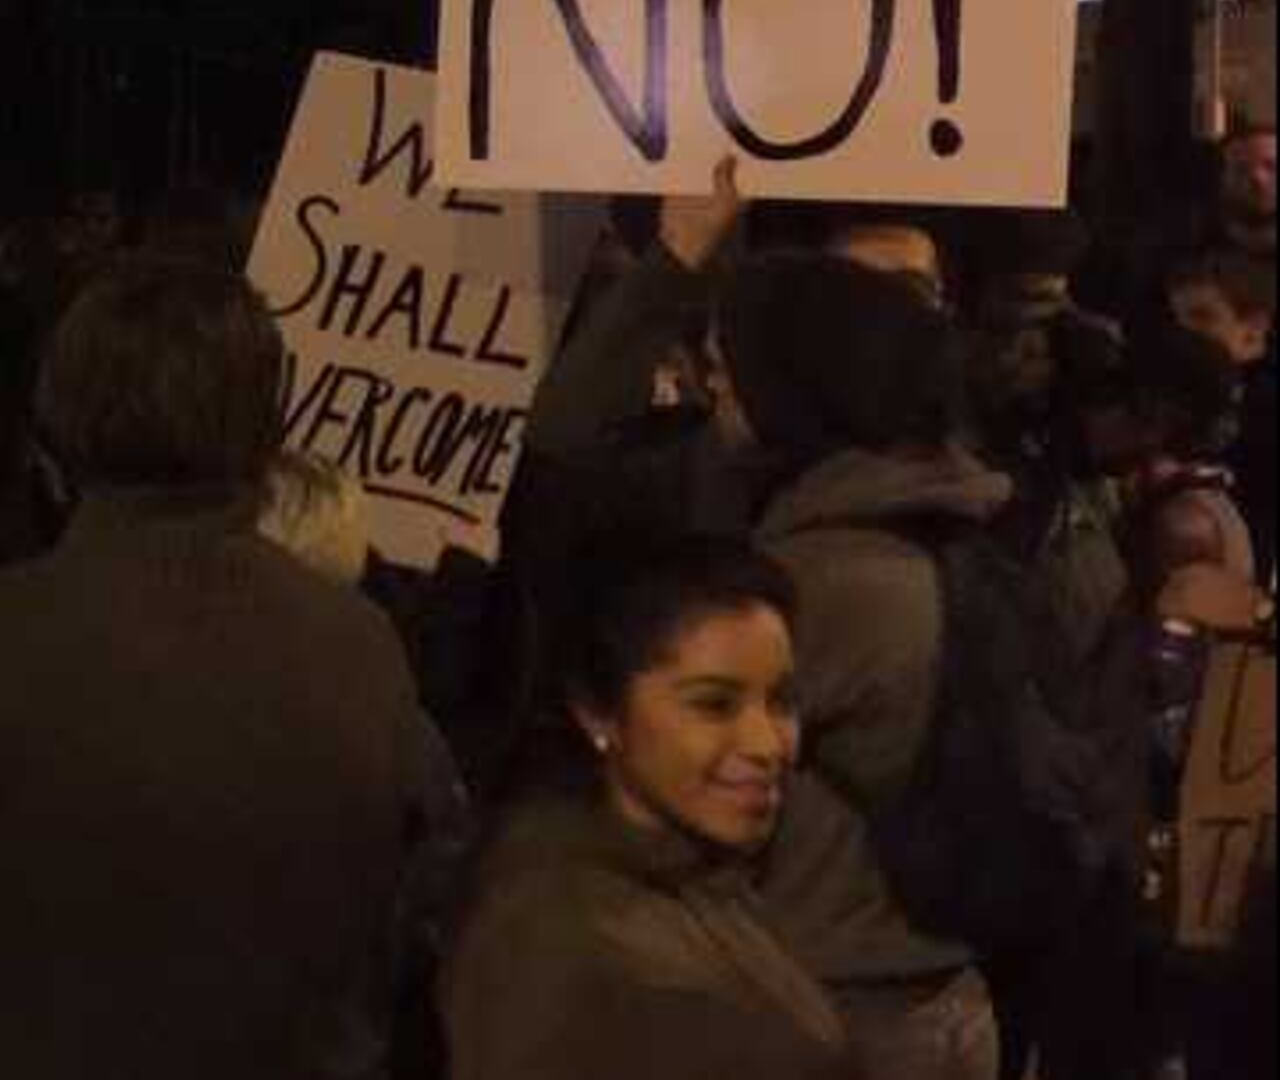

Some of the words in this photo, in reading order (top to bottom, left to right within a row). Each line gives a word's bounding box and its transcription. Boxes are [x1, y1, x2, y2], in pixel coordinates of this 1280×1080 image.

[357, 66, 503, 215] W
[264, 195, 528, 369] SHALL
[280, 353, 532, 496] VERCOME
